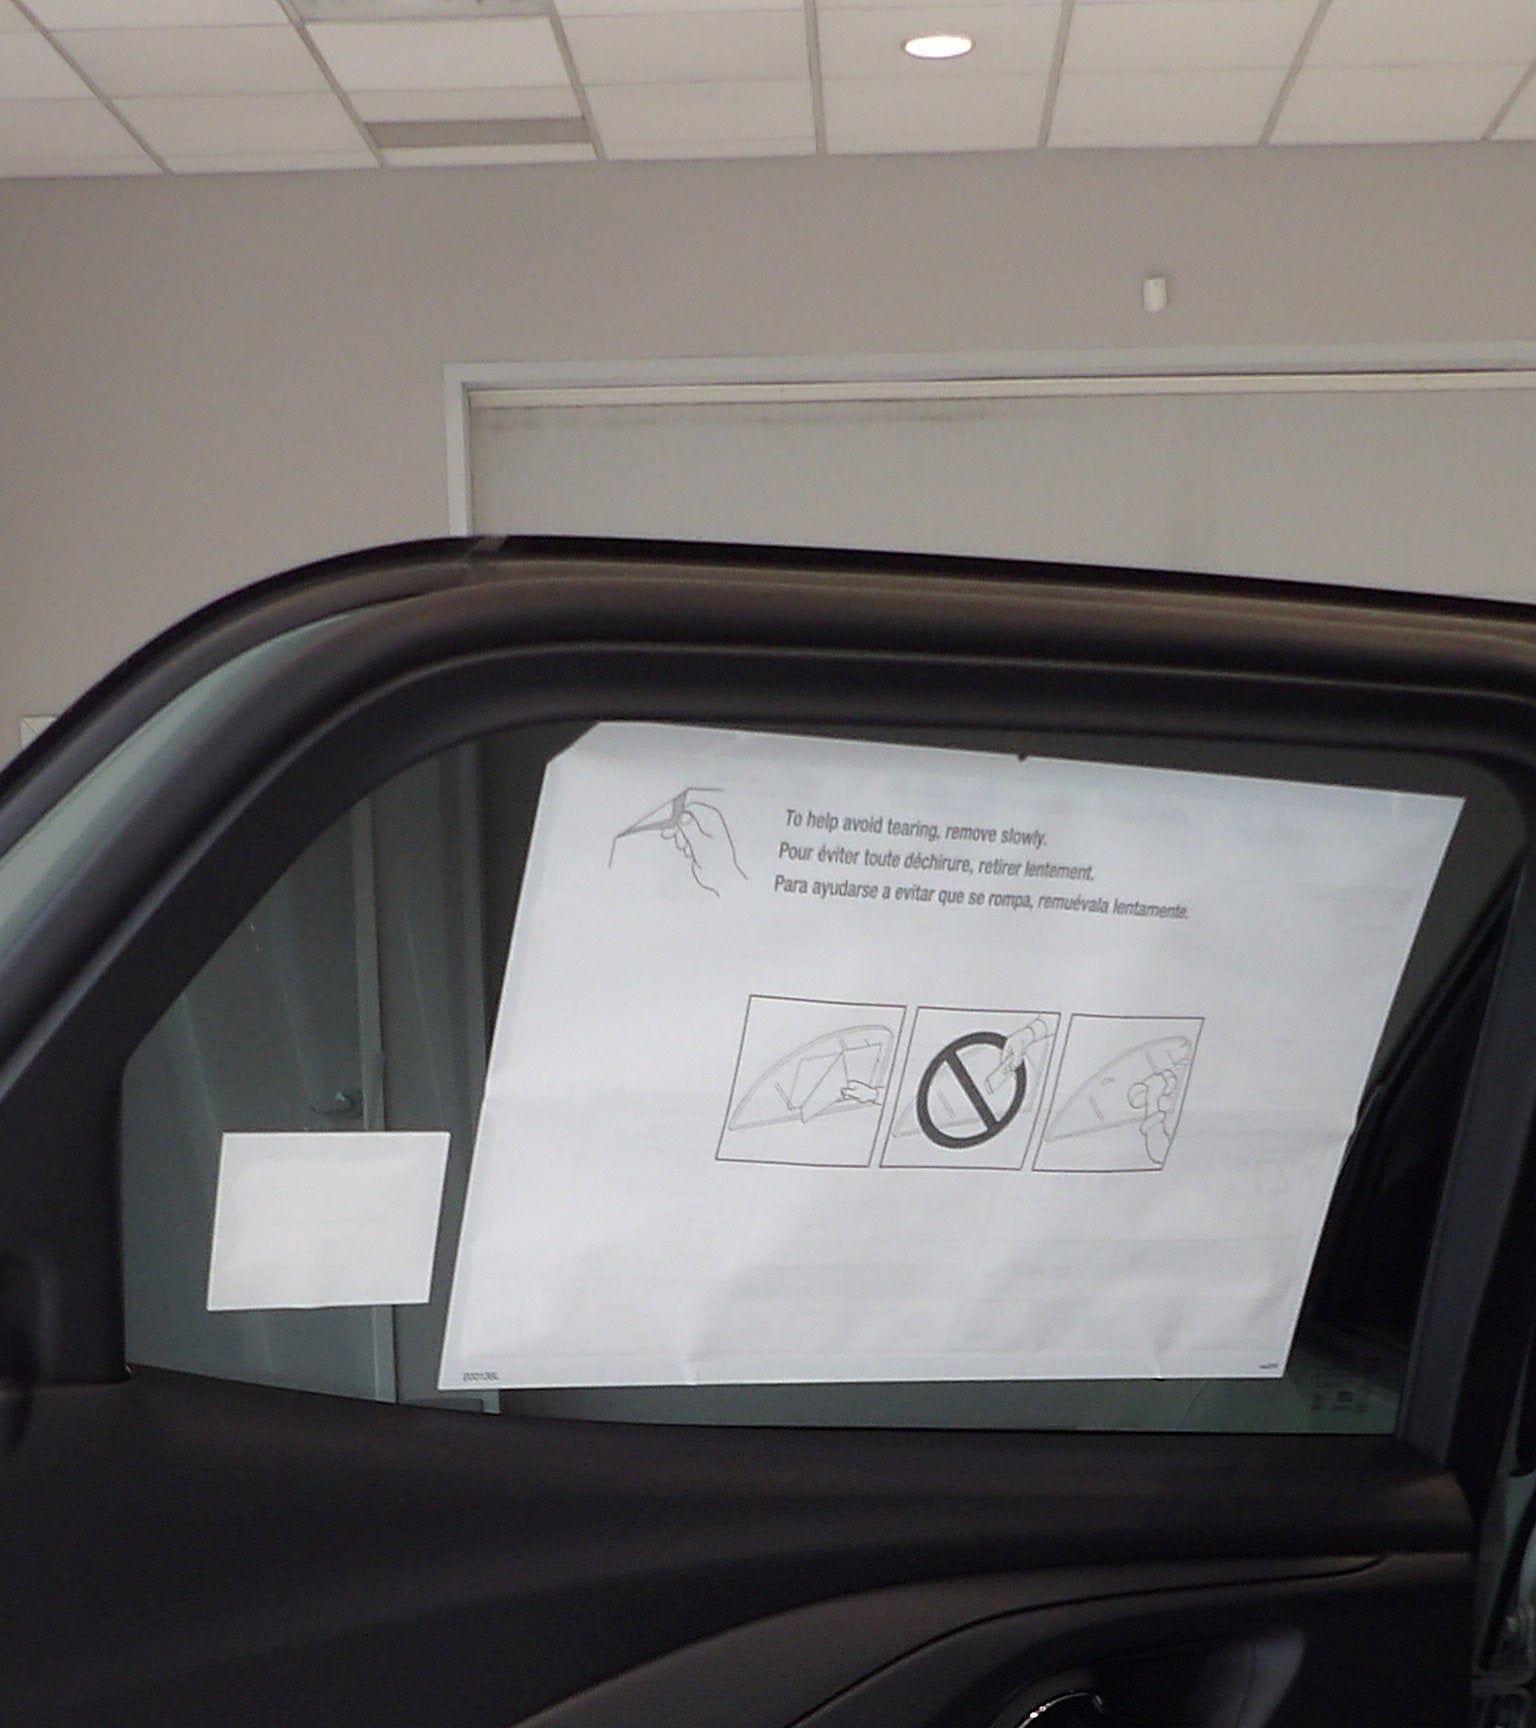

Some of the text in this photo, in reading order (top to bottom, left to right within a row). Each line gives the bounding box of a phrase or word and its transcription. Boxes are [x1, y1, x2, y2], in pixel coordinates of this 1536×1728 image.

[786, 809, 1047, 849] To help avoid tearing, remove slowly.
[779, 841, 1094, 881] Pour éviter toute déchirure, retirer lentement.
[774, 874, 1188, 920] Para ayudarse a evitar que se rompa, remuévala lentamente.
